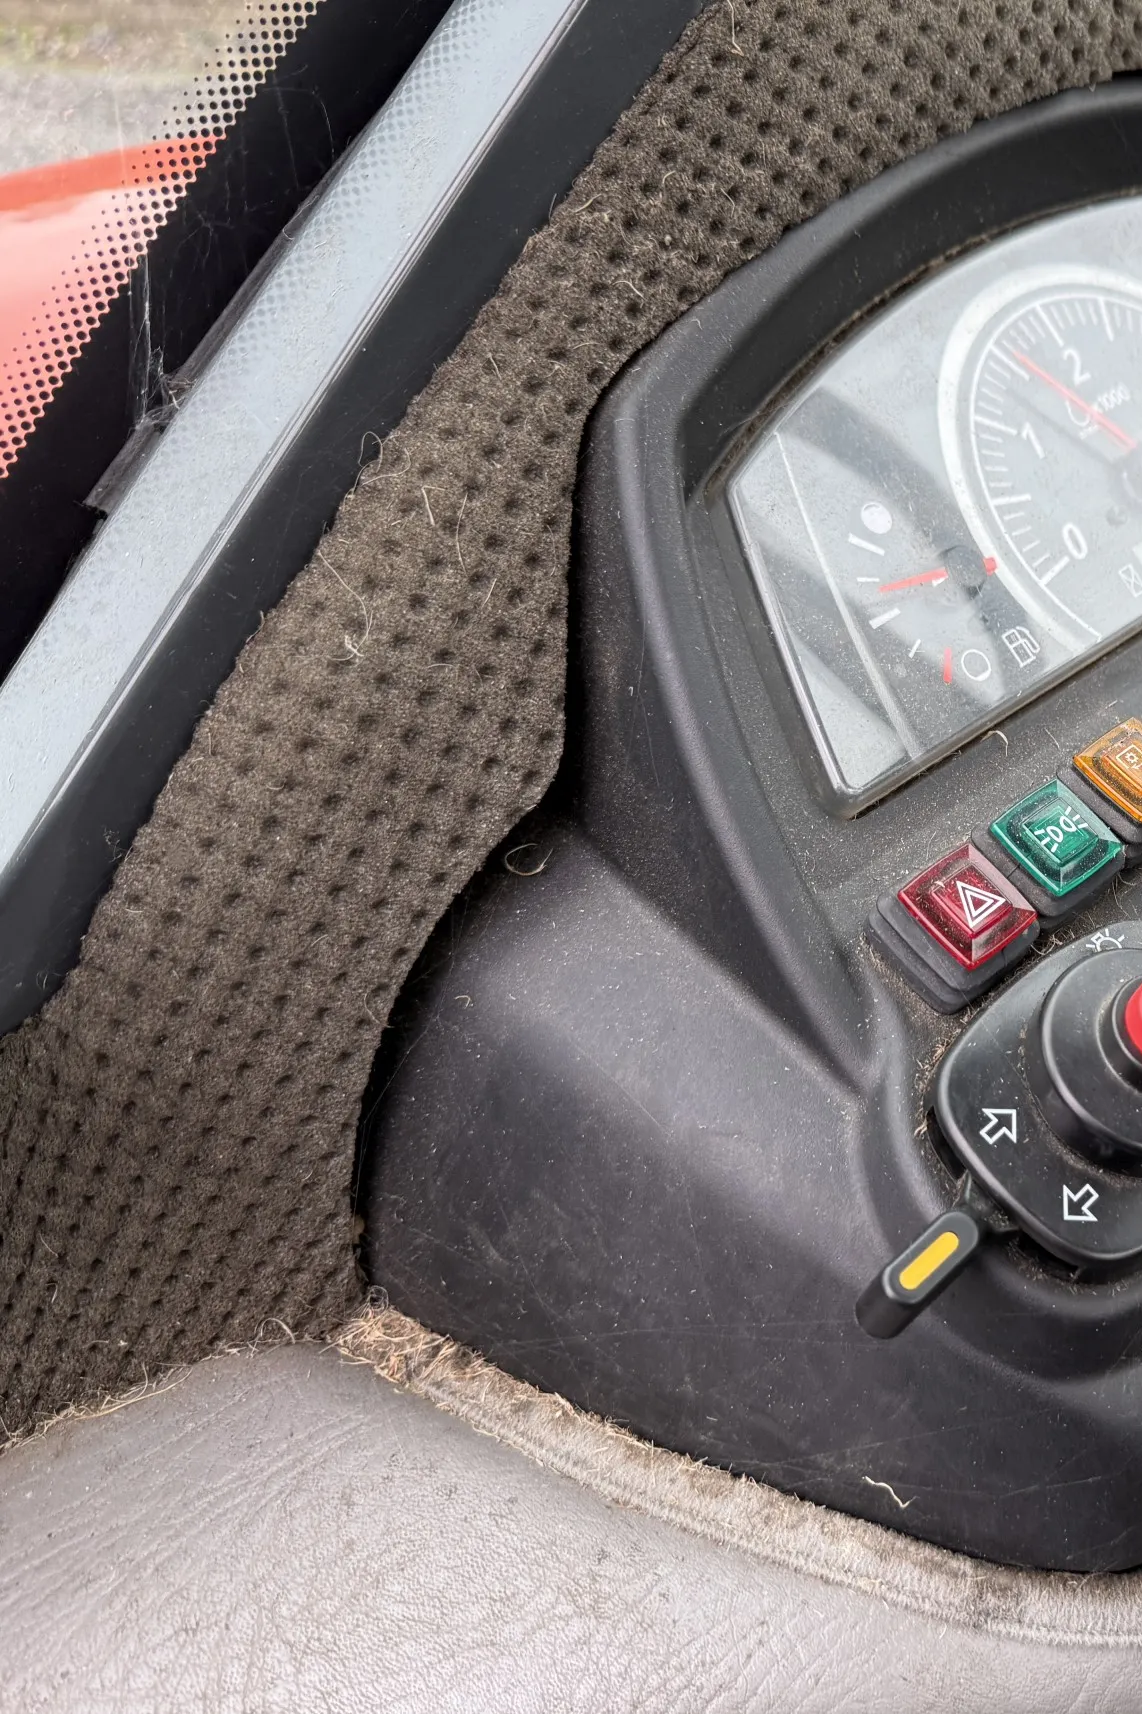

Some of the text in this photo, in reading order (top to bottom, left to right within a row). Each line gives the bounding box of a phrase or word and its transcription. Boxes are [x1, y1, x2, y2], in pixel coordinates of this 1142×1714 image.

[1063, 348, 1091, 385] 2
[1021, 422, 1046, 459] 1
[1062, 522, 1088, 560] 0
